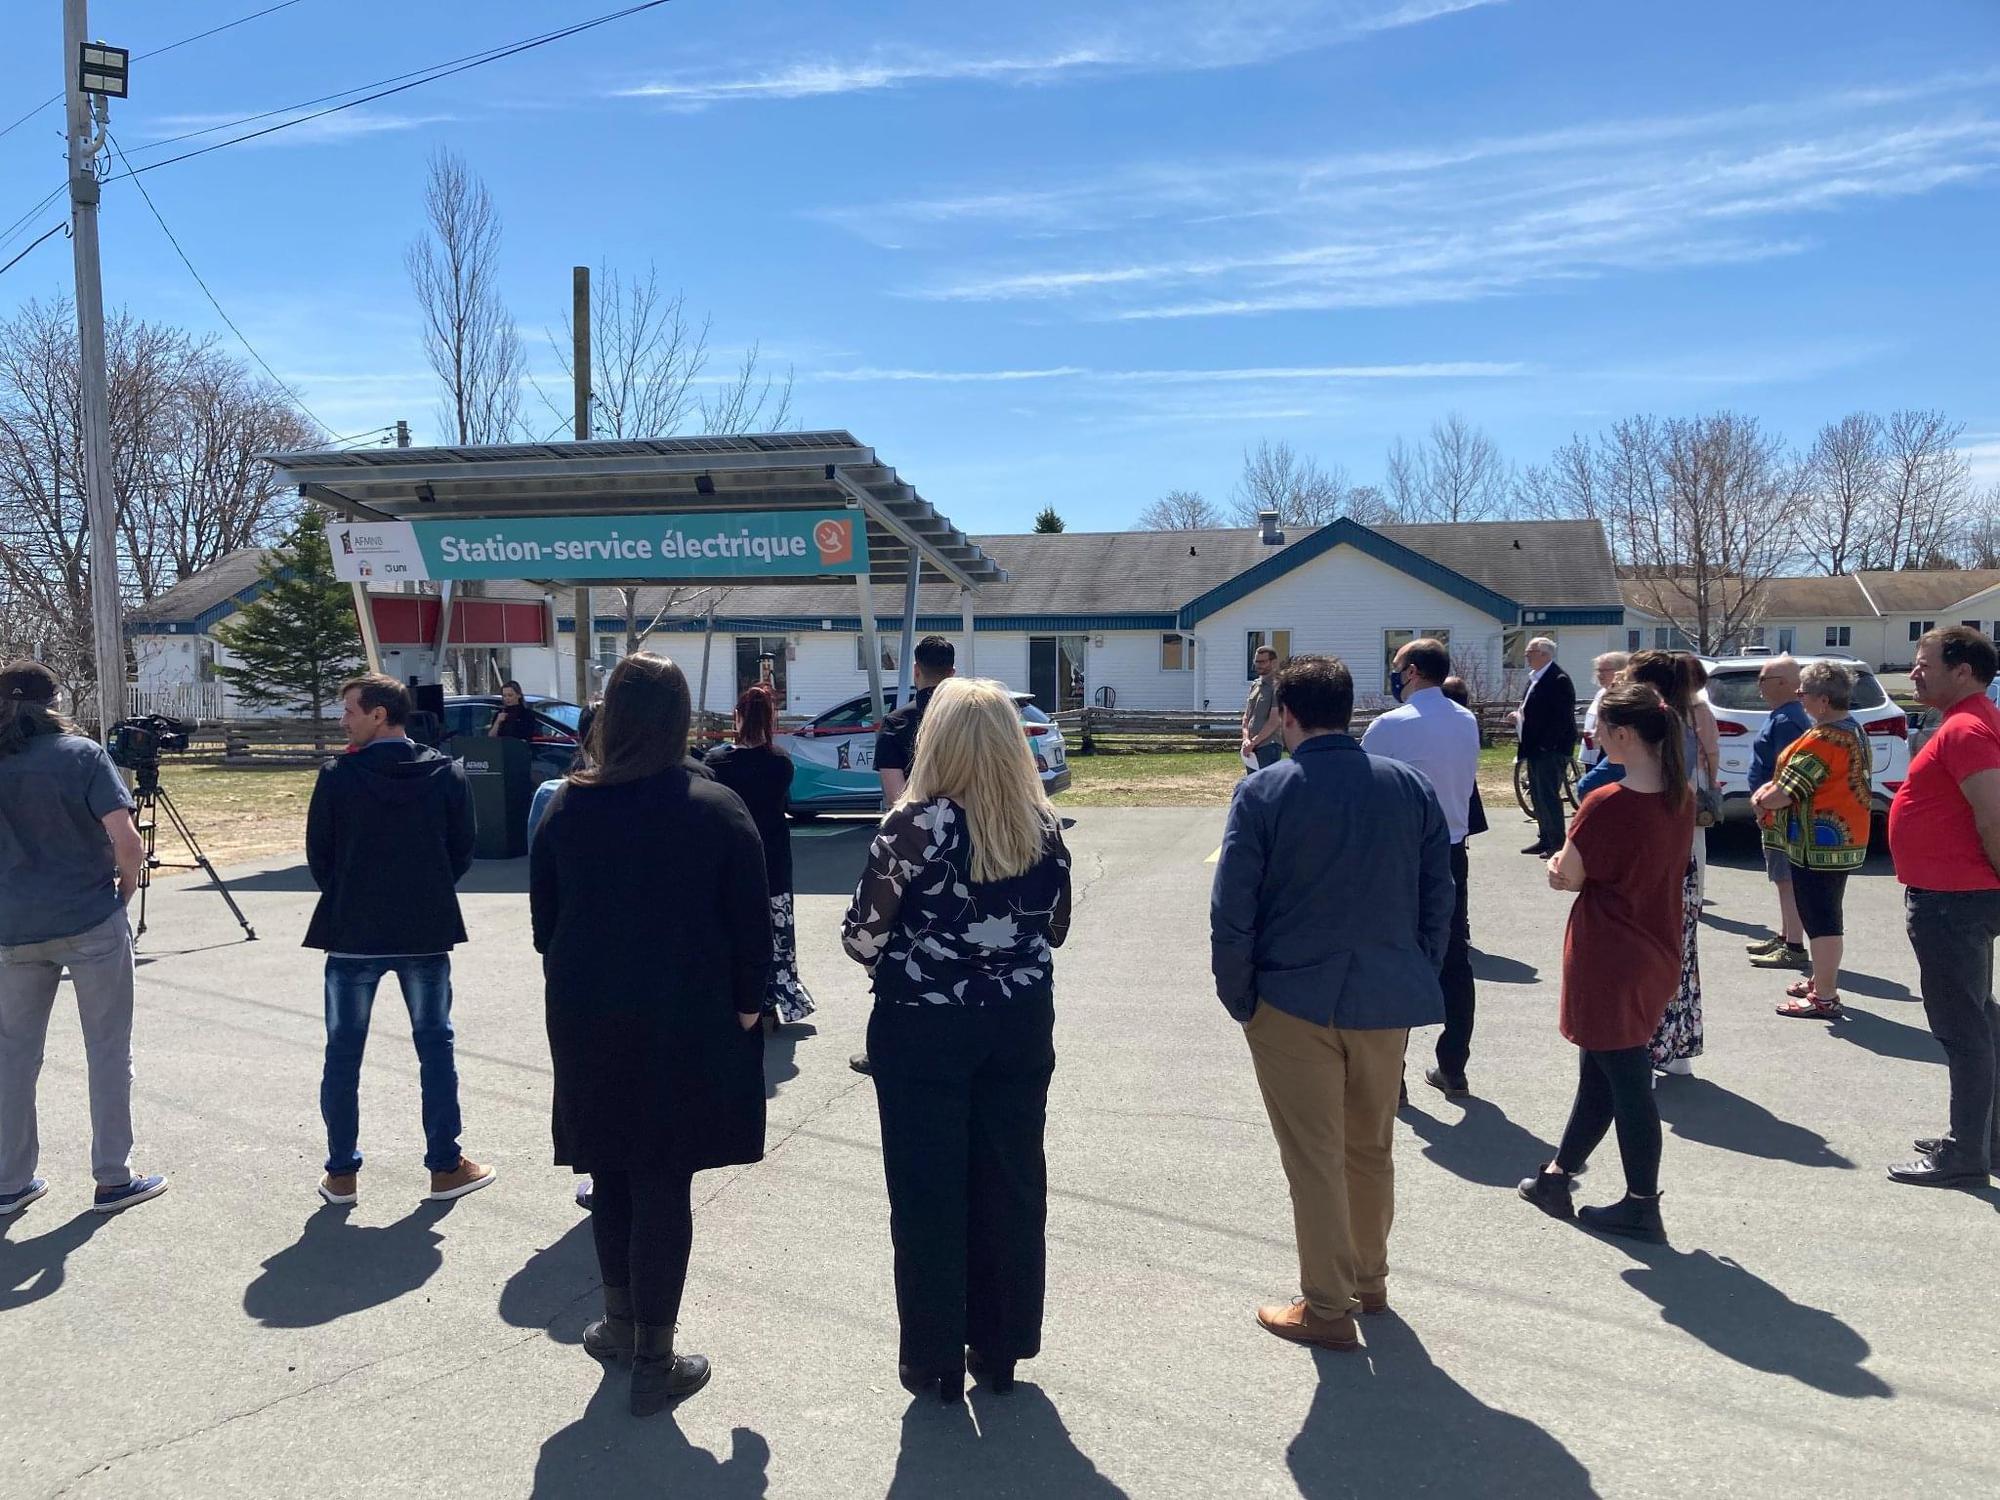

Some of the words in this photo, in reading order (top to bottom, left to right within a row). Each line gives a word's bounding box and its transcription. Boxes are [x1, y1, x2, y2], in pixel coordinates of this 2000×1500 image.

[354, 536, 383, 546] AFMNB
[440, 531, 654, 562] Station-service
[661, 528, 807, 563] électrique
